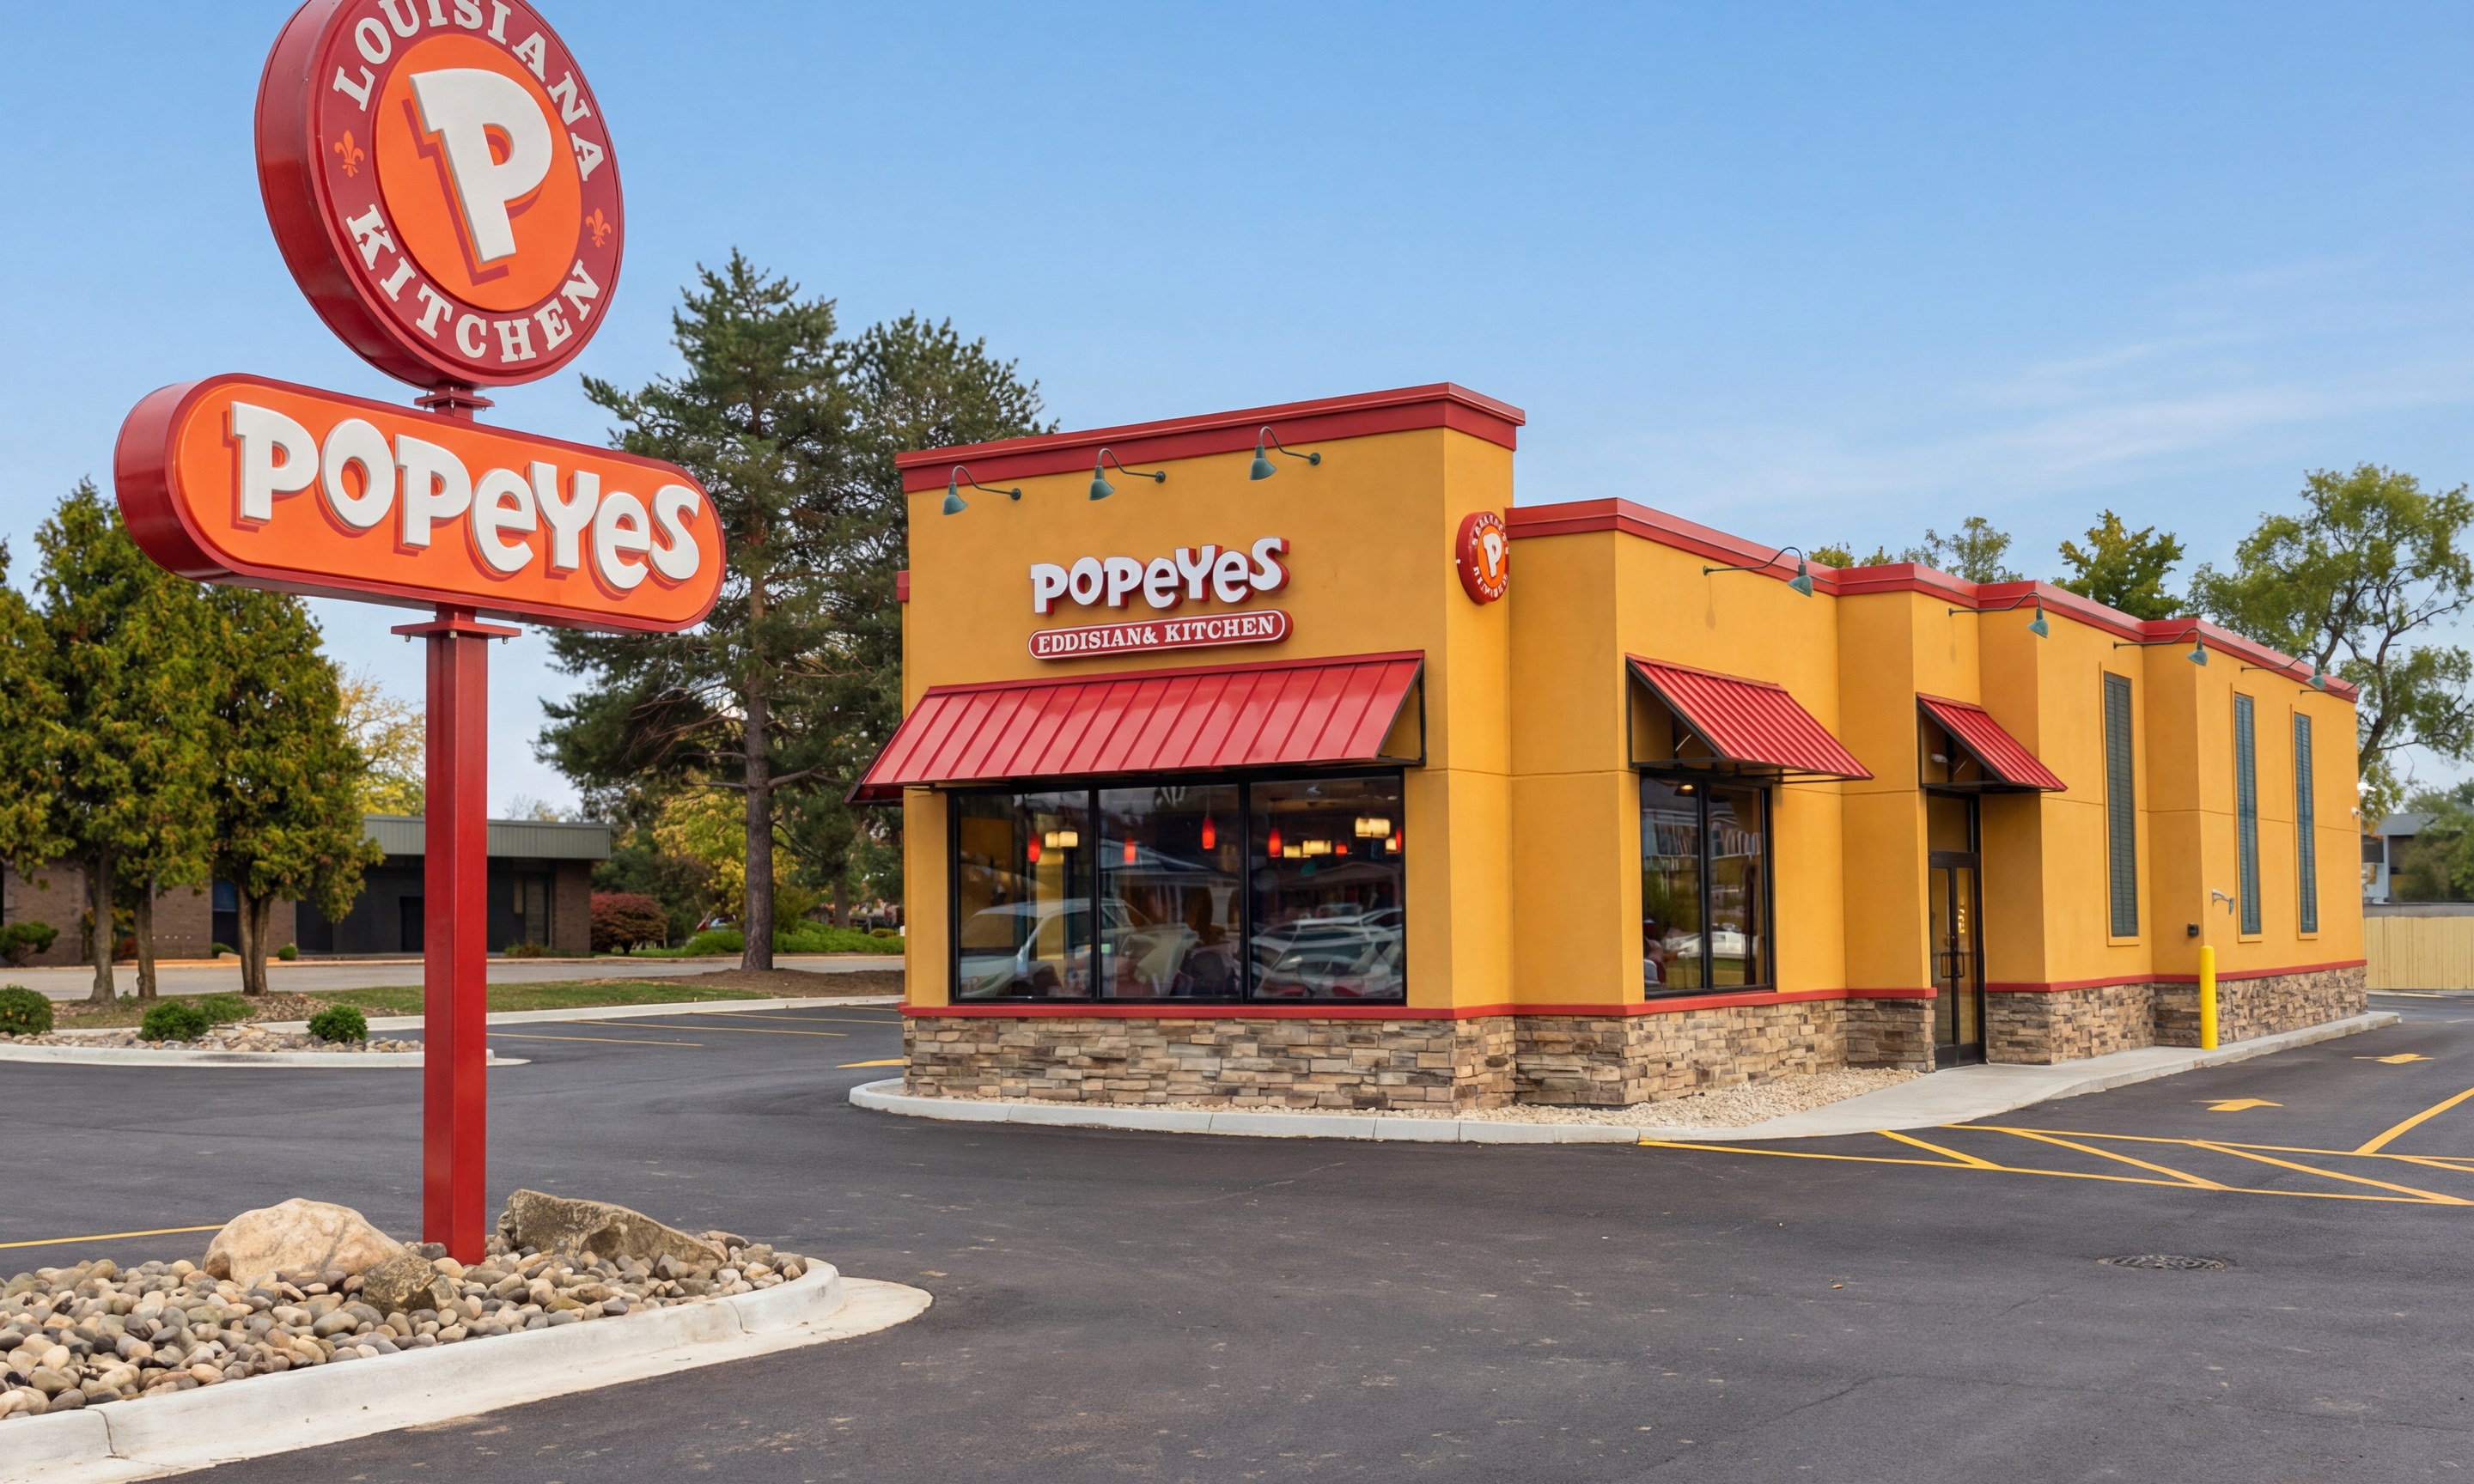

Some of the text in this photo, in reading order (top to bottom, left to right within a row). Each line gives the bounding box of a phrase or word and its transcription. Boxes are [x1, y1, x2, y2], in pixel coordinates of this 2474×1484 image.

[332, 0, 605, 182] LOUISIANA
[408, 67, 552, 265] P
[345, 204, 600, 363] KITCHEN
[1164, 615, 1275, 643] KITCHEN
[1483, 532, 1502, 578] P
